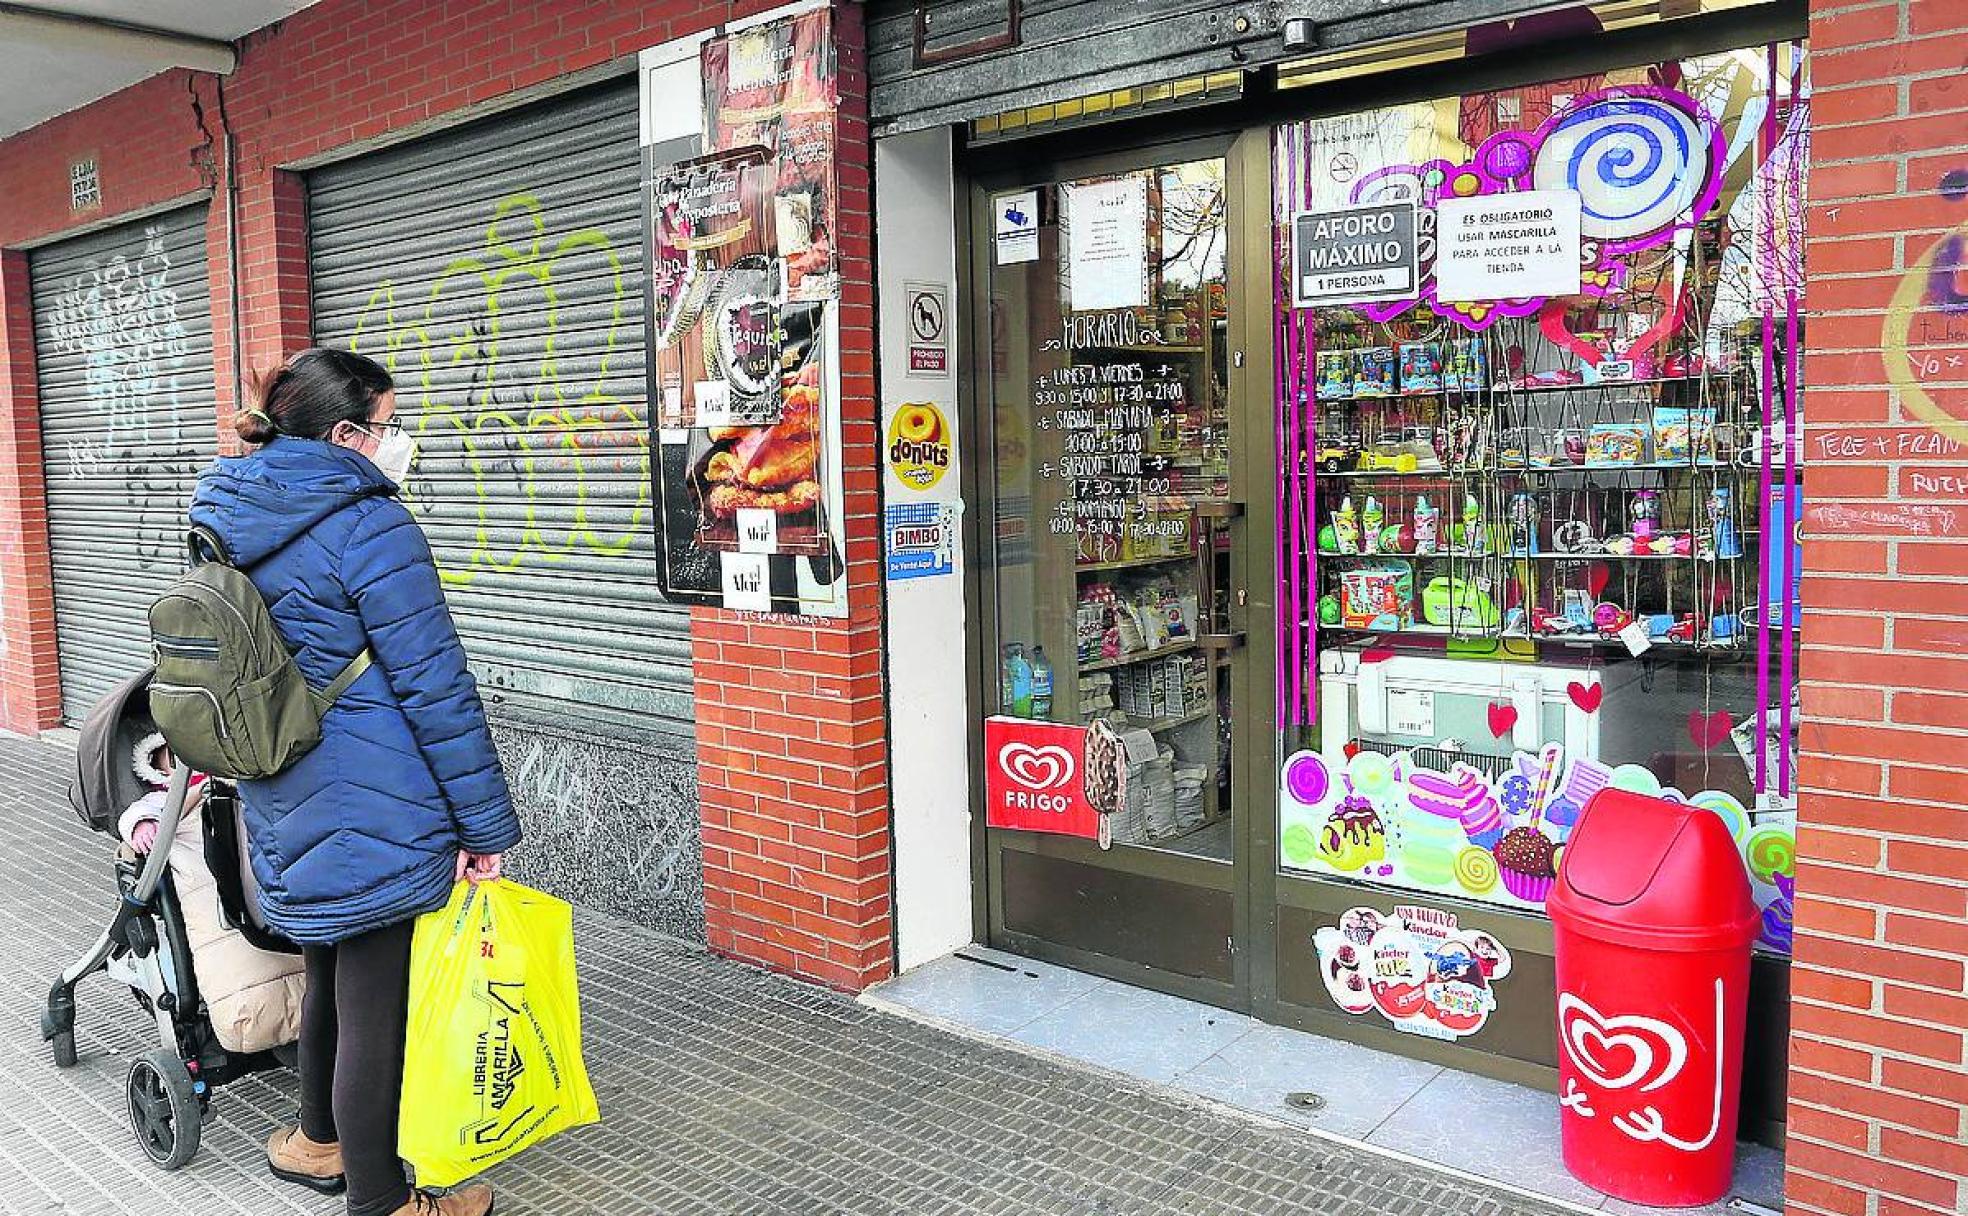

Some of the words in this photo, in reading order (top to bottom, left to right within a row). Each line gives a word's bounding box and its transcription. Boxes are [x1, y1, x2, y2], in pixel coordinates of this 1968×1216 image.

[1314, 211, 1395, 241] AFORO
[1462, 214, 1475, 225] ES
[1479, 208, 1553, 225] OBLIGATORIO
[1457, 231, 1484, 243] USAR
[1488, 227, 1557, 241] MASCARILLA
[1309, 241, 1402, 270] MÁXIMO
[1452, 250, 1479, 260] PARA
[1484, 245, 1530, 258] ACCEDER
[1535, 244, 1543, 254] A
[1548, 242, 1562, 254] LA
[1486, 262, 1525, 274] TIENDA
[1318, 279, 1324, 290] 1
[1327, 274, 1385, 289] PERSONA
[1063, 311, 1136, 350] HORARIO
[1053, 366, 1087, 386] LUNES
[1100, 363, 1144, 383] VIERNES
[1104, 405, 1154, 430] MAÑANA
[890, 437, 948, 467] donuts
[1896, 432, 1961, 456] FRAN
[1111, 452, 1143, 475] TARDE
[1077, 499, 1126, 519] DOMINGO
[895, 528, 940, 546] BIMBO
[1005, 790, 1068, 814] FRIGO
[1396, 905, 1413, 920] UN
[473, 1031, 489, 1096] LIBRERIA
[491, 1017, 509, 1109] AMARILLA
